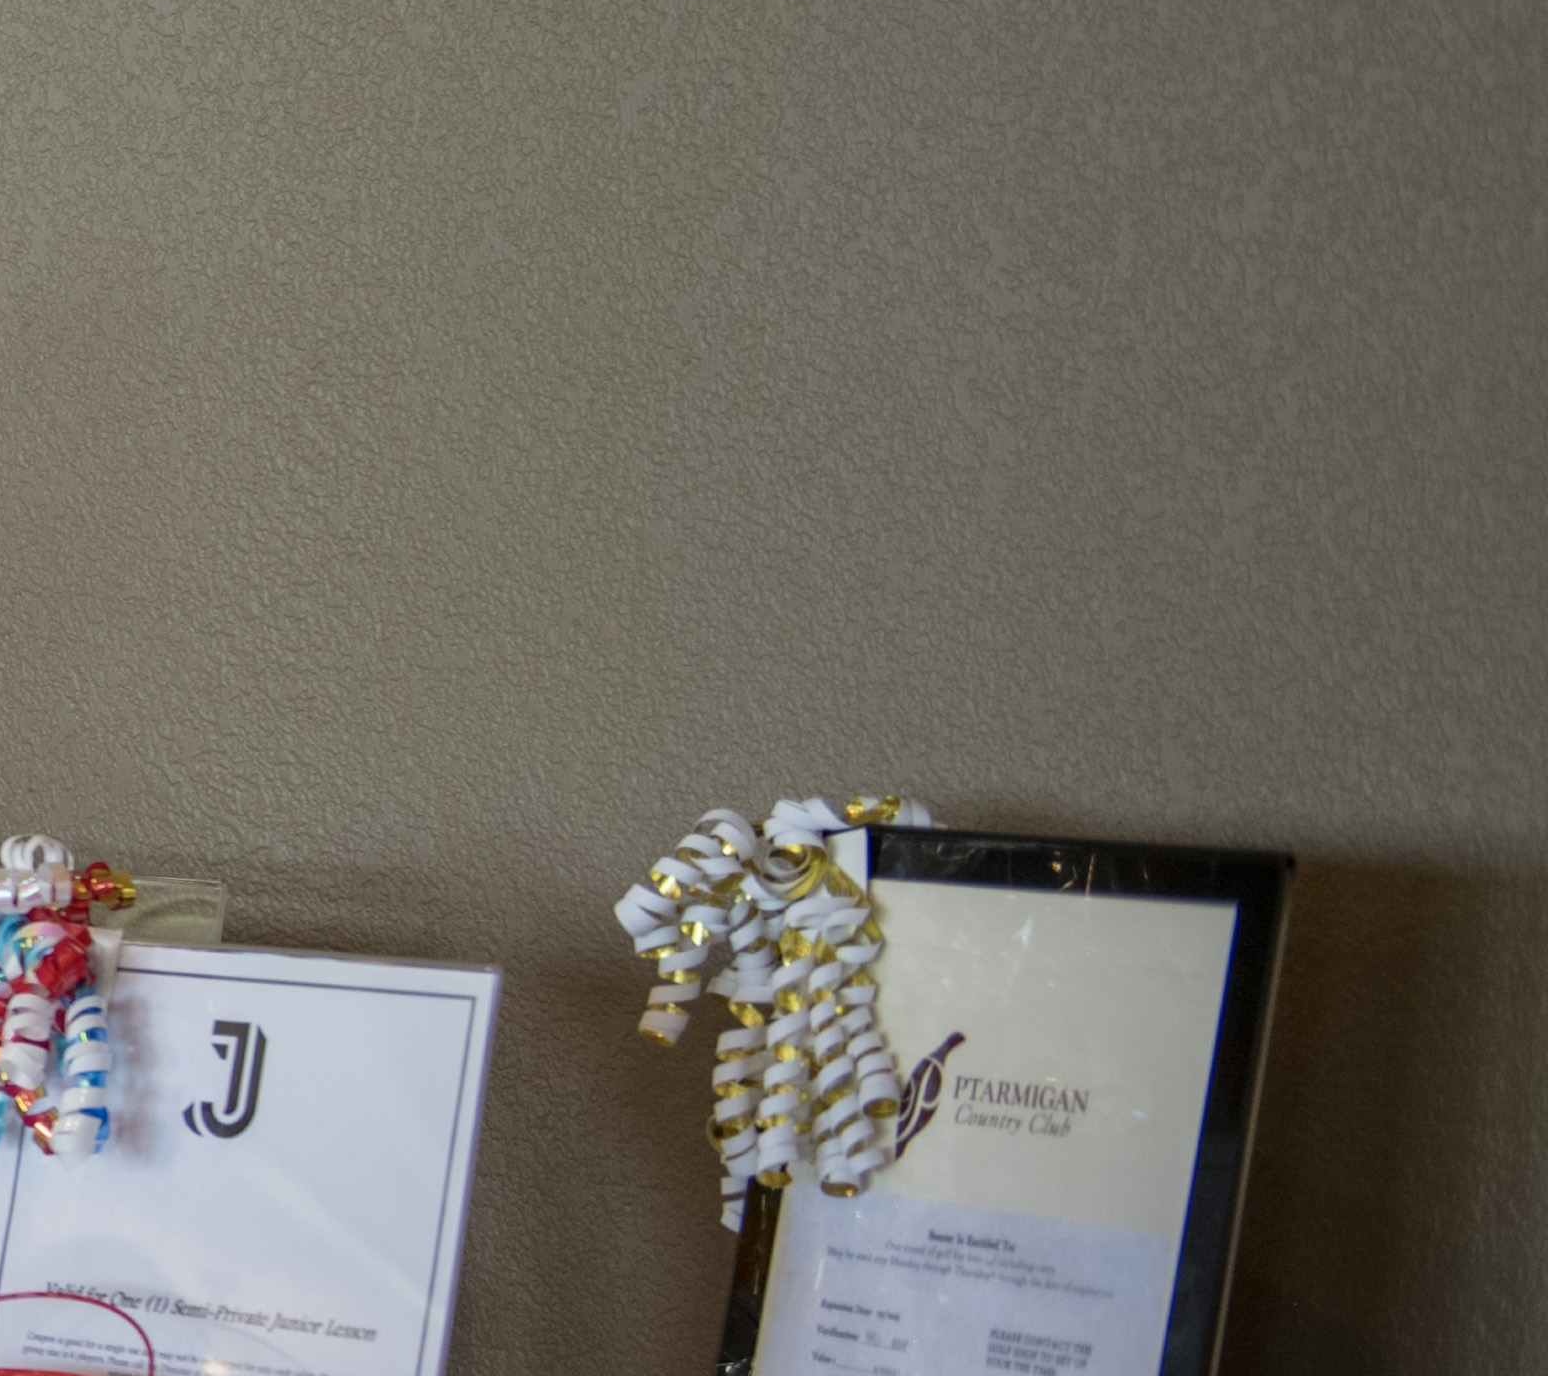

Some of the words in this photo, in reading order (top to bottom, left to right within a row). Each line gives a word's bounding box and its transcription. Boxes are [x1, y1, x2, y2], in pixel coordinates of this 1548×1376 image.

[954, 1075, 1090, 1115] PTARMIGAN
[954, 1103, 1024, 1136] Country
[1028, 1112, 1072, 1137] Club
[109, 1290, 142, 1309] One
[170, 1298, 270, 1327] Semi-Private
[267, 1312, 322, 1333] Junior
[325, 1320, 379, 1342] Lesson
